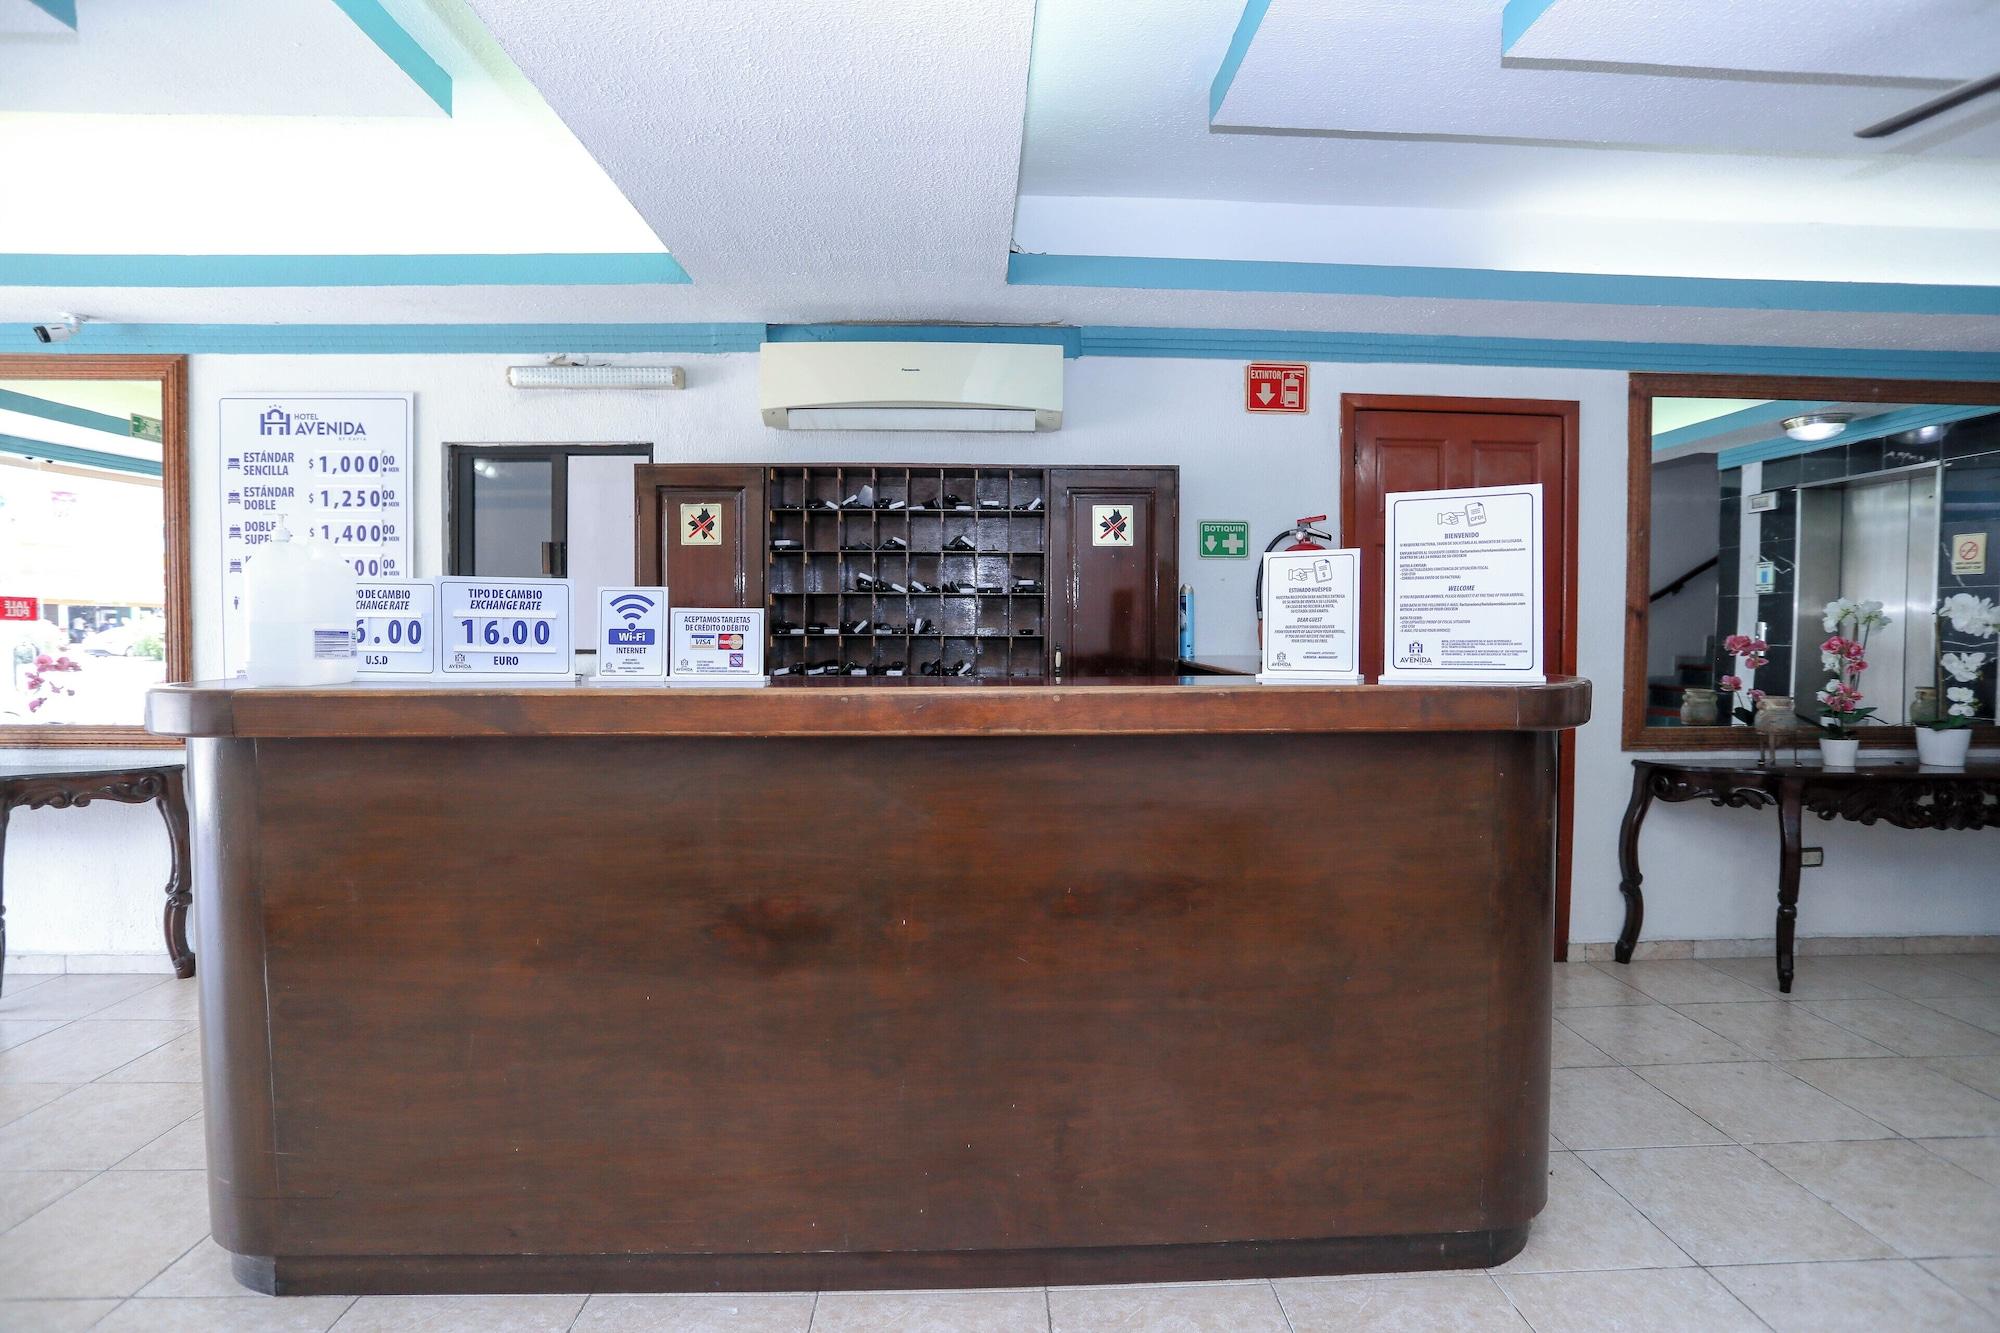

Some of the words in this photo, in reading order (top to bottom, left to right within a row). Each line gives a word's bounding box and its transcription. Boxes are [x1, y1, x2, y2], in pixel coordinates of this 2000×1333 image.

[1250, 370, 1282, 379] EXTINTOR
[295, 422, 366, 435] AVENIDA
[243, 451, 295, 463] ESTÁNDAR
[308, 458, 314, 469] $
[319, 455, 379, 474] 1,000
[243, 465, 289, 476] SENCILLA
[243, 485, 295, 498] ESTÁNDAR
[308, 493, 314, 504] $
[320, 490, 380, 509] 1,250
[244, 500, 276, 510] DOBLE
[1204, 525, 1245, 533] BOTIQUIN
[309, 528, 315, 538] $
[321, 525, 380, 544] 1,400
[365, 590, 376, 599] DE
[377, 590, 411, 600] CAMBIO
[468, 589, 491, 599] TIPO
[492, 590, 504, 599] DE
[505, 590, 543, 600] CAMBIO
[356, 601, 389, 610] CHANGE
[389, 601, 410, 610] RATE
[470, 600, 518, 610] EXCHANGE
[519, 601, 541, 611] RATE
[721, 616, 751, 624] TARJETAS
[356, 619, 422, 645] 6.00
[461, 619, 550, 645] 16.00
[694, 623, 720, 632] CRÉDITO
[726, 624, 749, 632] DÉBITO
[618, 632, 646, 642] Wi-Fi
[366, 656, 388, 665] U.S.D
[493, 656, 519, 666] EURO
